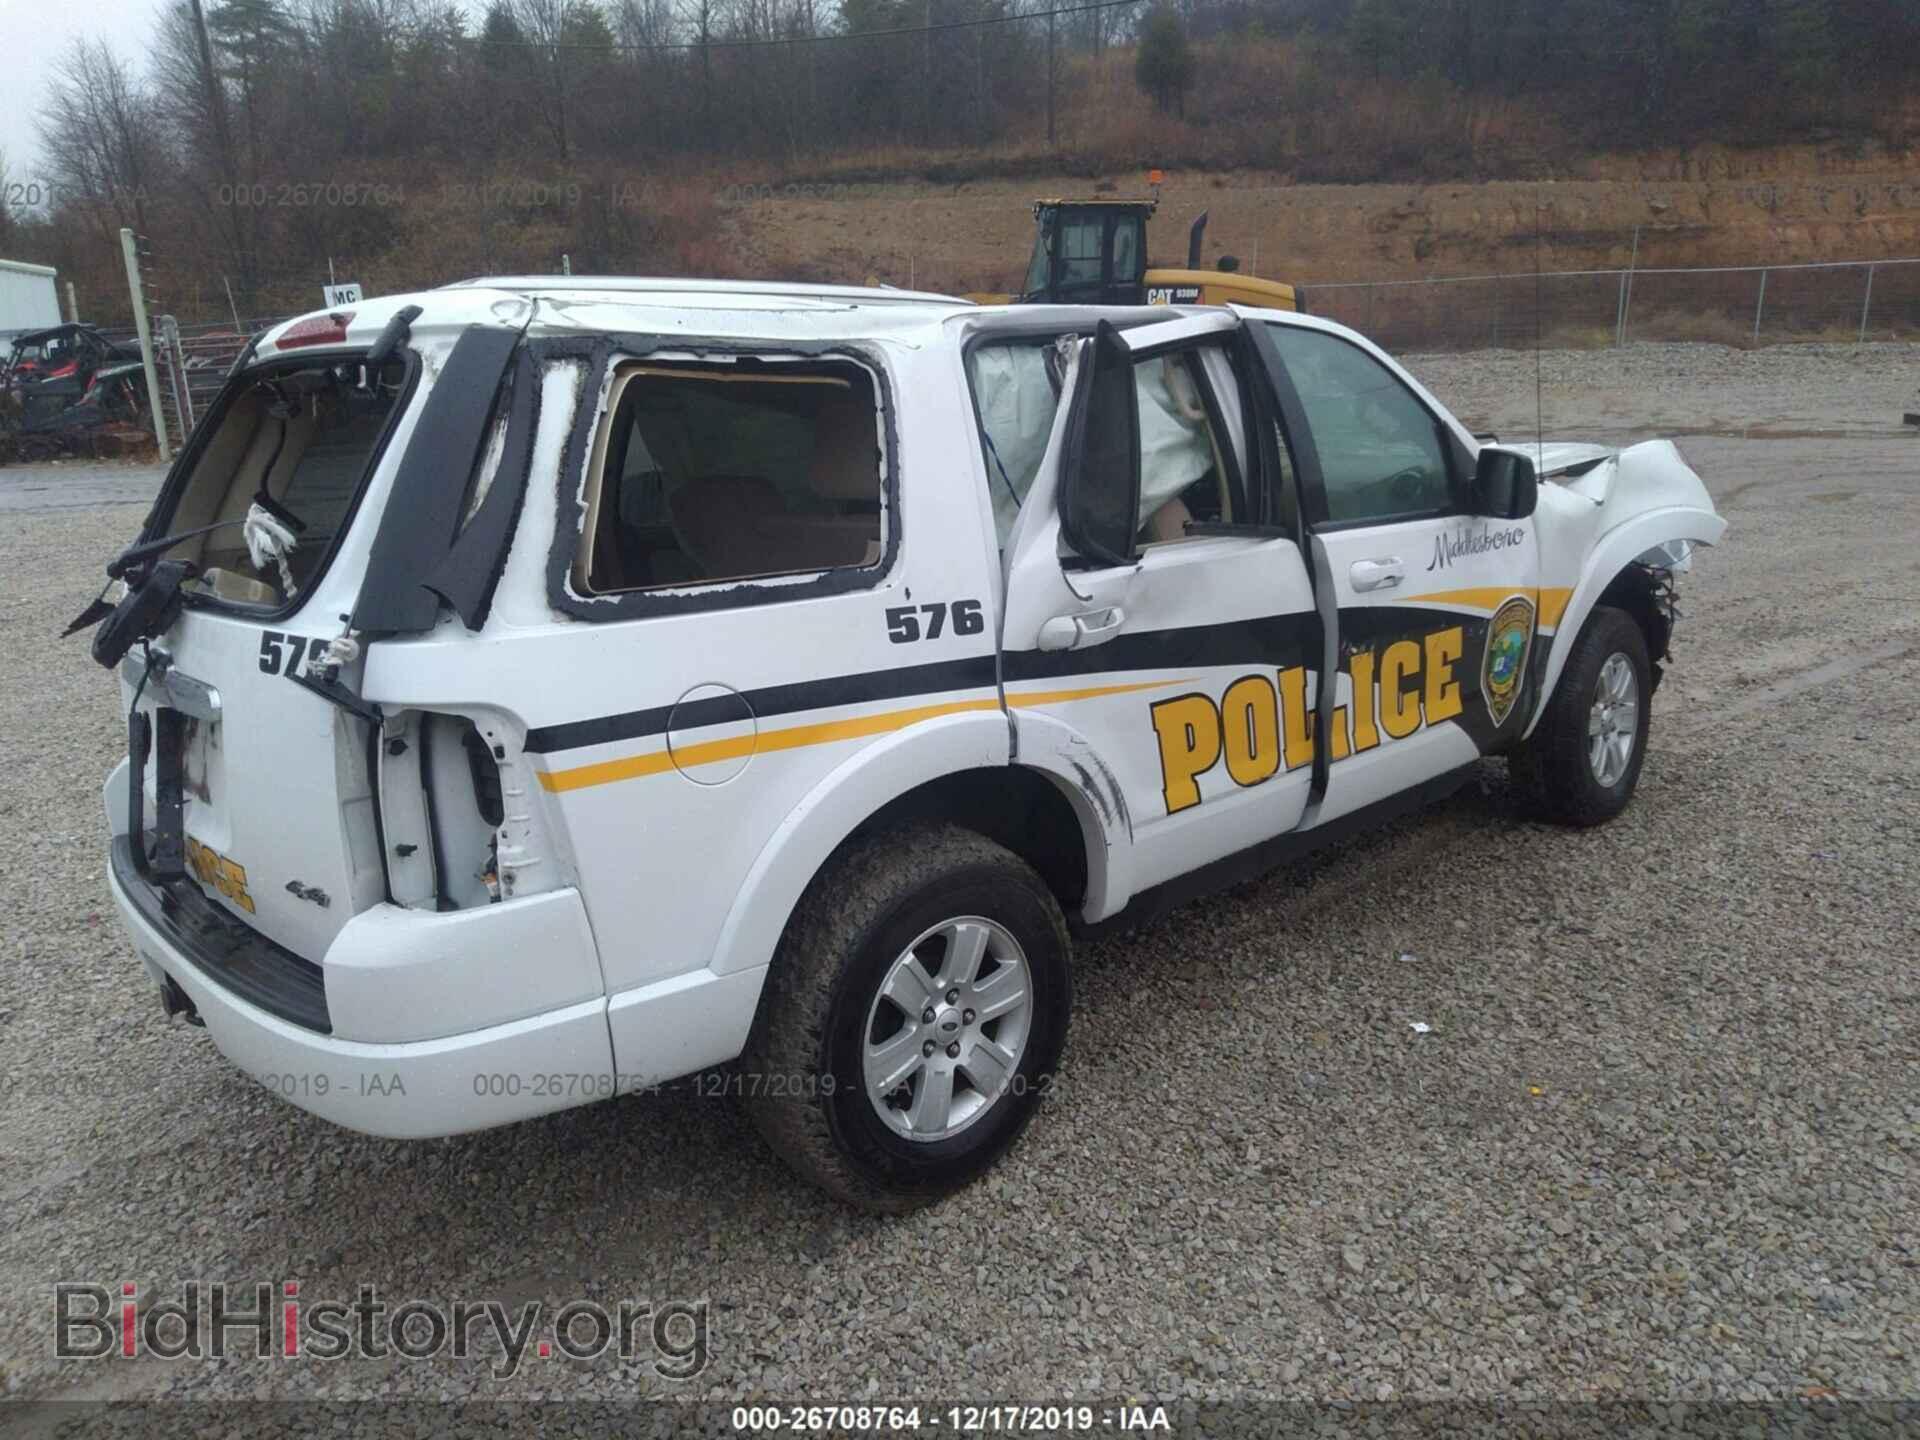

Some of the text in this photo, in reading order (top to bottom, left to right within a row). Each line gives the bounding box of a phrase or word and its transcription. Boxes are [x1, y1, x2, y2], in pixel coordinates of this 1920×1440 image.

[1147, 288, 1174, 304] CAT
[1426, 522, 1525, 571] Middlesboro
[885, 599, 984, 644] 576
[1149, 624, 1464, 815] POLICE
